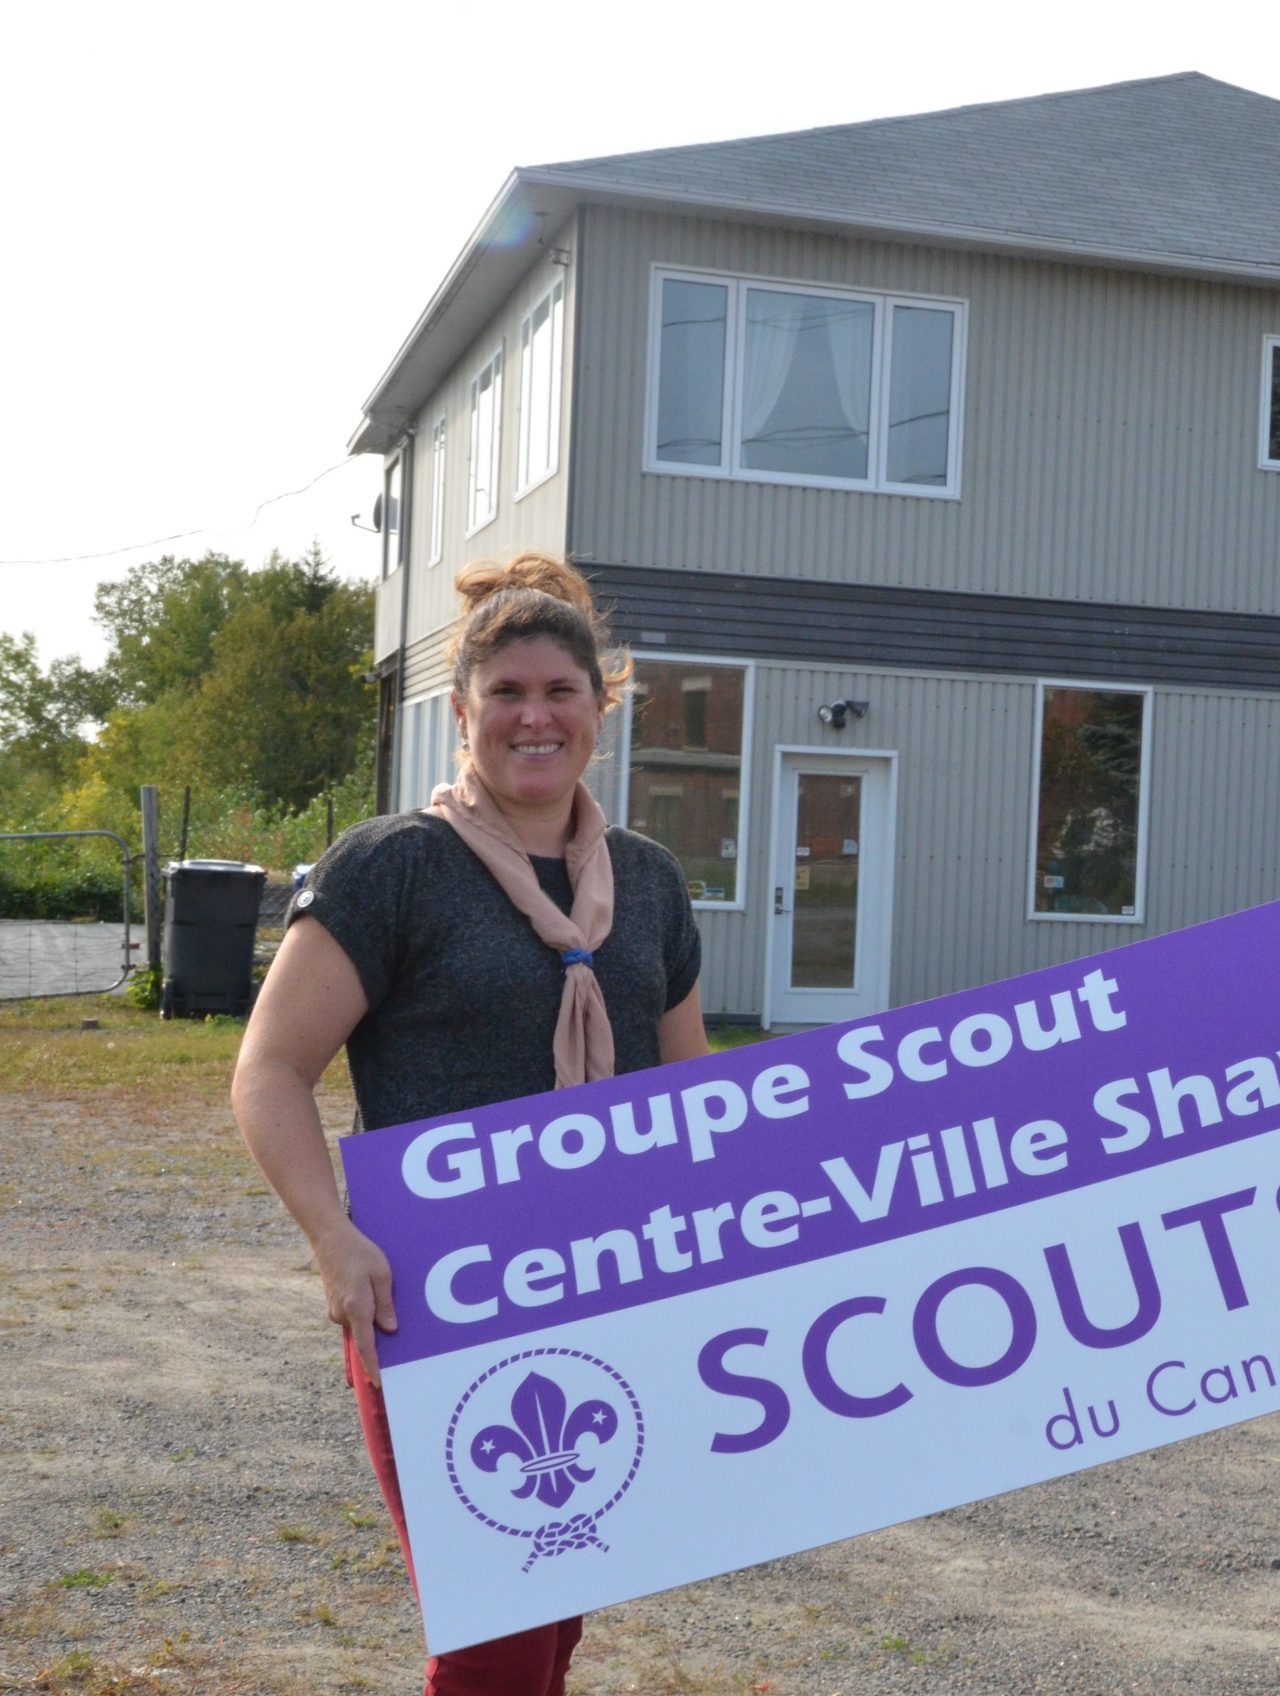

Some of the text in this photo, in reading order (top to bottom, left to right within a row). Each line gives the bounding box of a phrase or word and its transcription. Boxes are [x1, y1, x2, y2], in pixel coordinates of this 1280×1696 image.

[401, 968, 1127, 1200] Groupe Scout
[424, 1116, 1068, 1324] Centre-Ville
[1045, 1387, 1120, 1451] du
